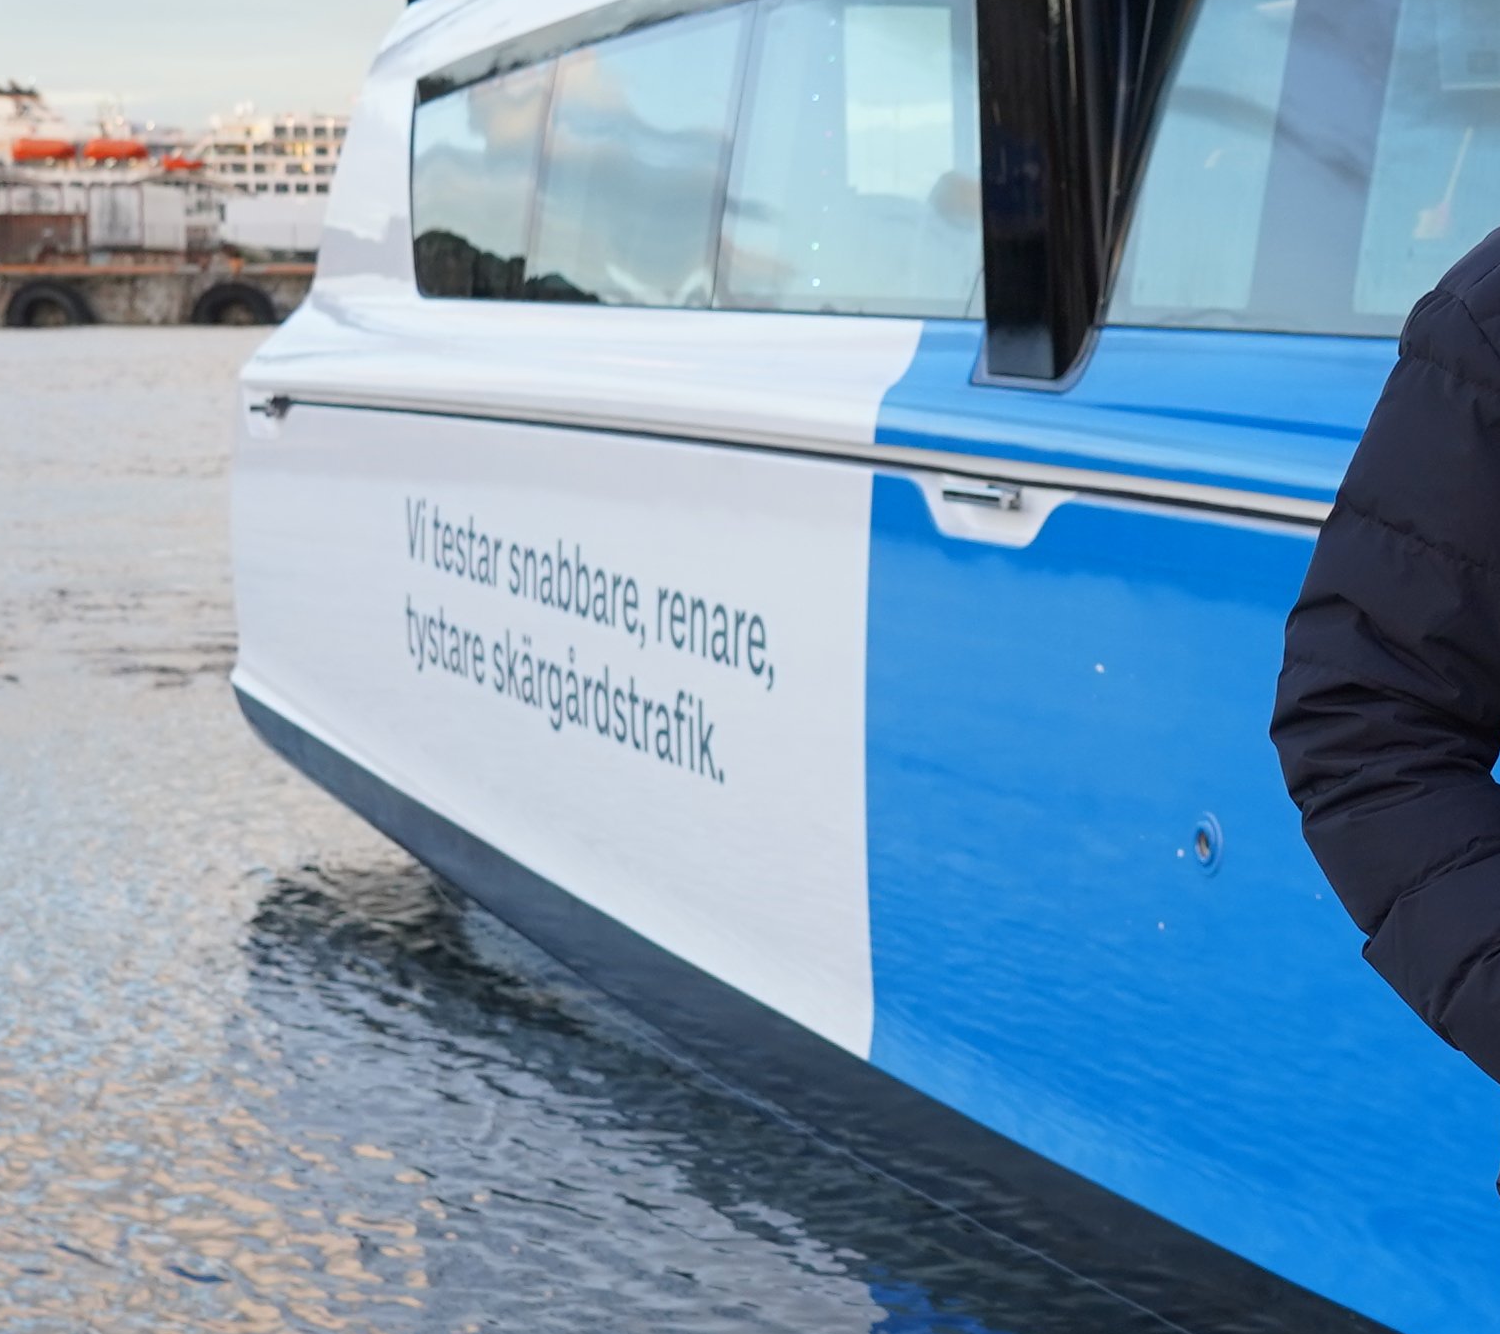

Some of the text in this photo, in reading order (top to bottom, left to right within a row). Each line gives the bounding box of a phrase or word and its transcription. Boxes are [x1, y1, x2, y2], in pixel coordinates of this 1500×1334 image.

[405, 495, 775, 691] Vi testar snabbare, renare,
[405, 593, 725, 784] tystare skärgårdstrafik.
